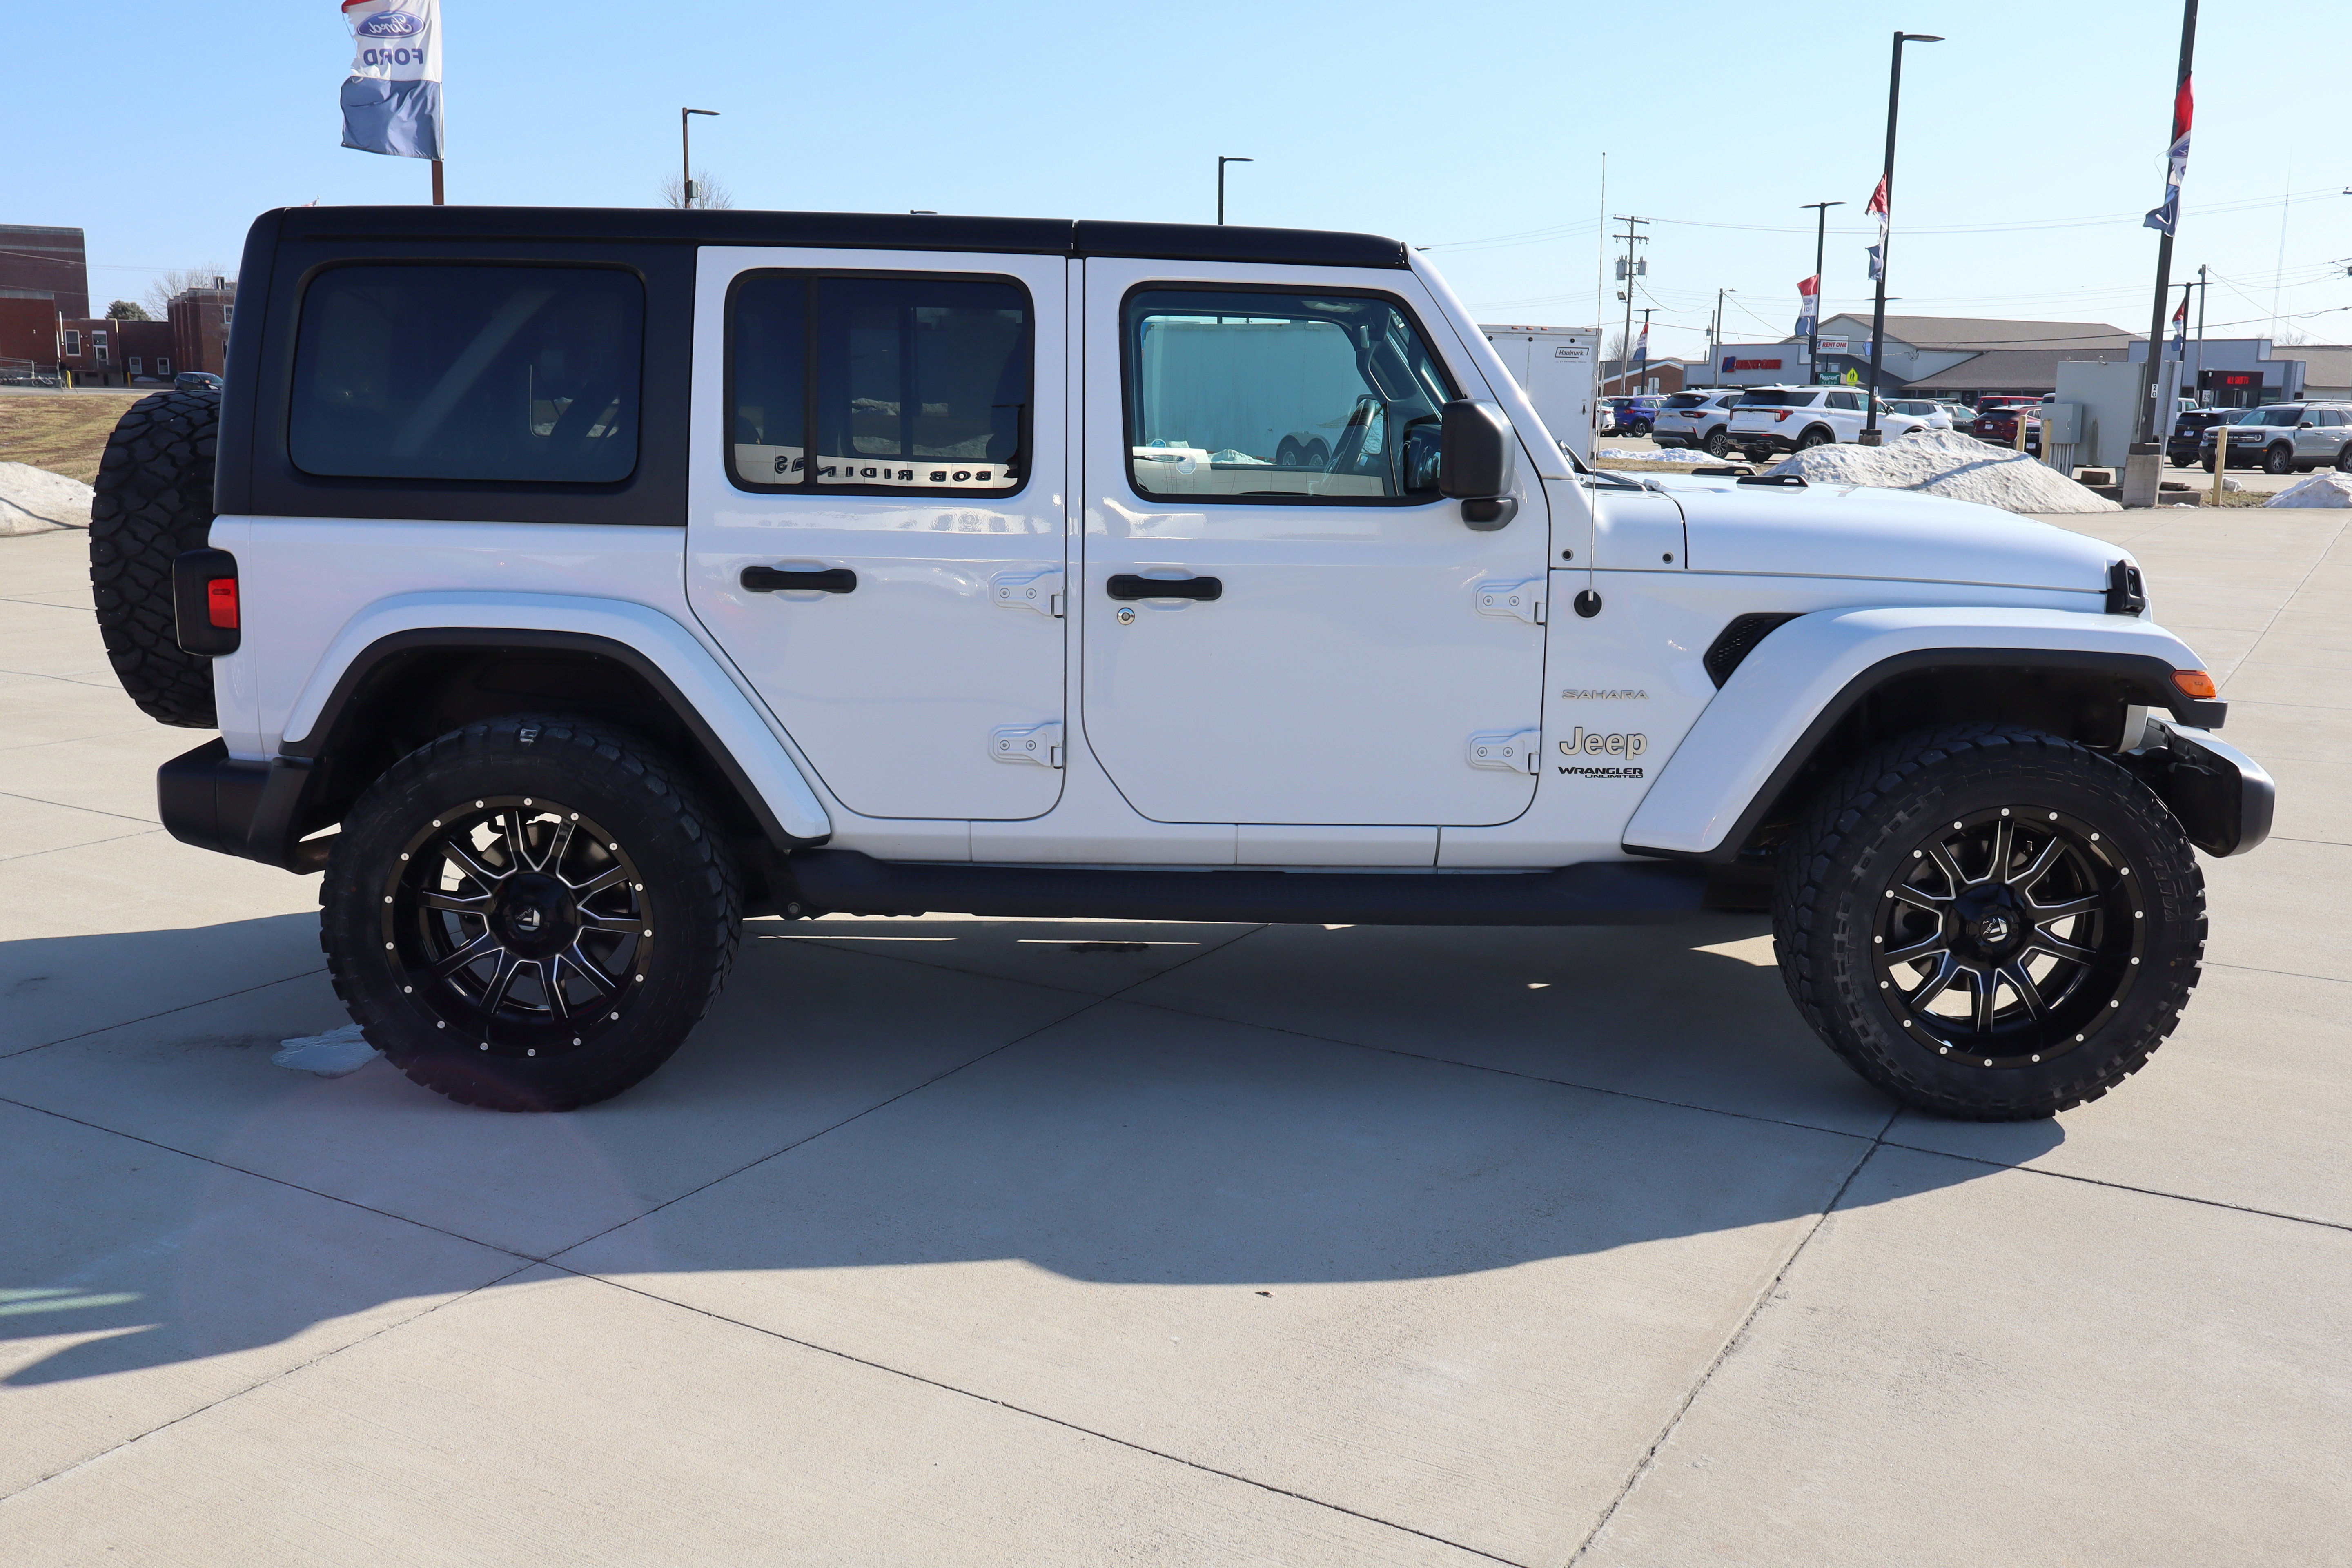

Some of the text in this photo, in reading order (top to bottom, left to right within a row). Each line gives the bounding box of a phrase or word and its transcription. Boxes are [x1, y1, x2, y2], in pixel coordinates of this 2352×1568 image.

[2152, 385, 2157, 397] 20
[1562, 689, 1649, 699] SAHARA
[1559, 726, 1647, 760] Jeep
[2145, 856, 2178, 922] KENDA
[516, 907, 532, 920] FUEL
[1982, 918, 1996, 935] FUEL
